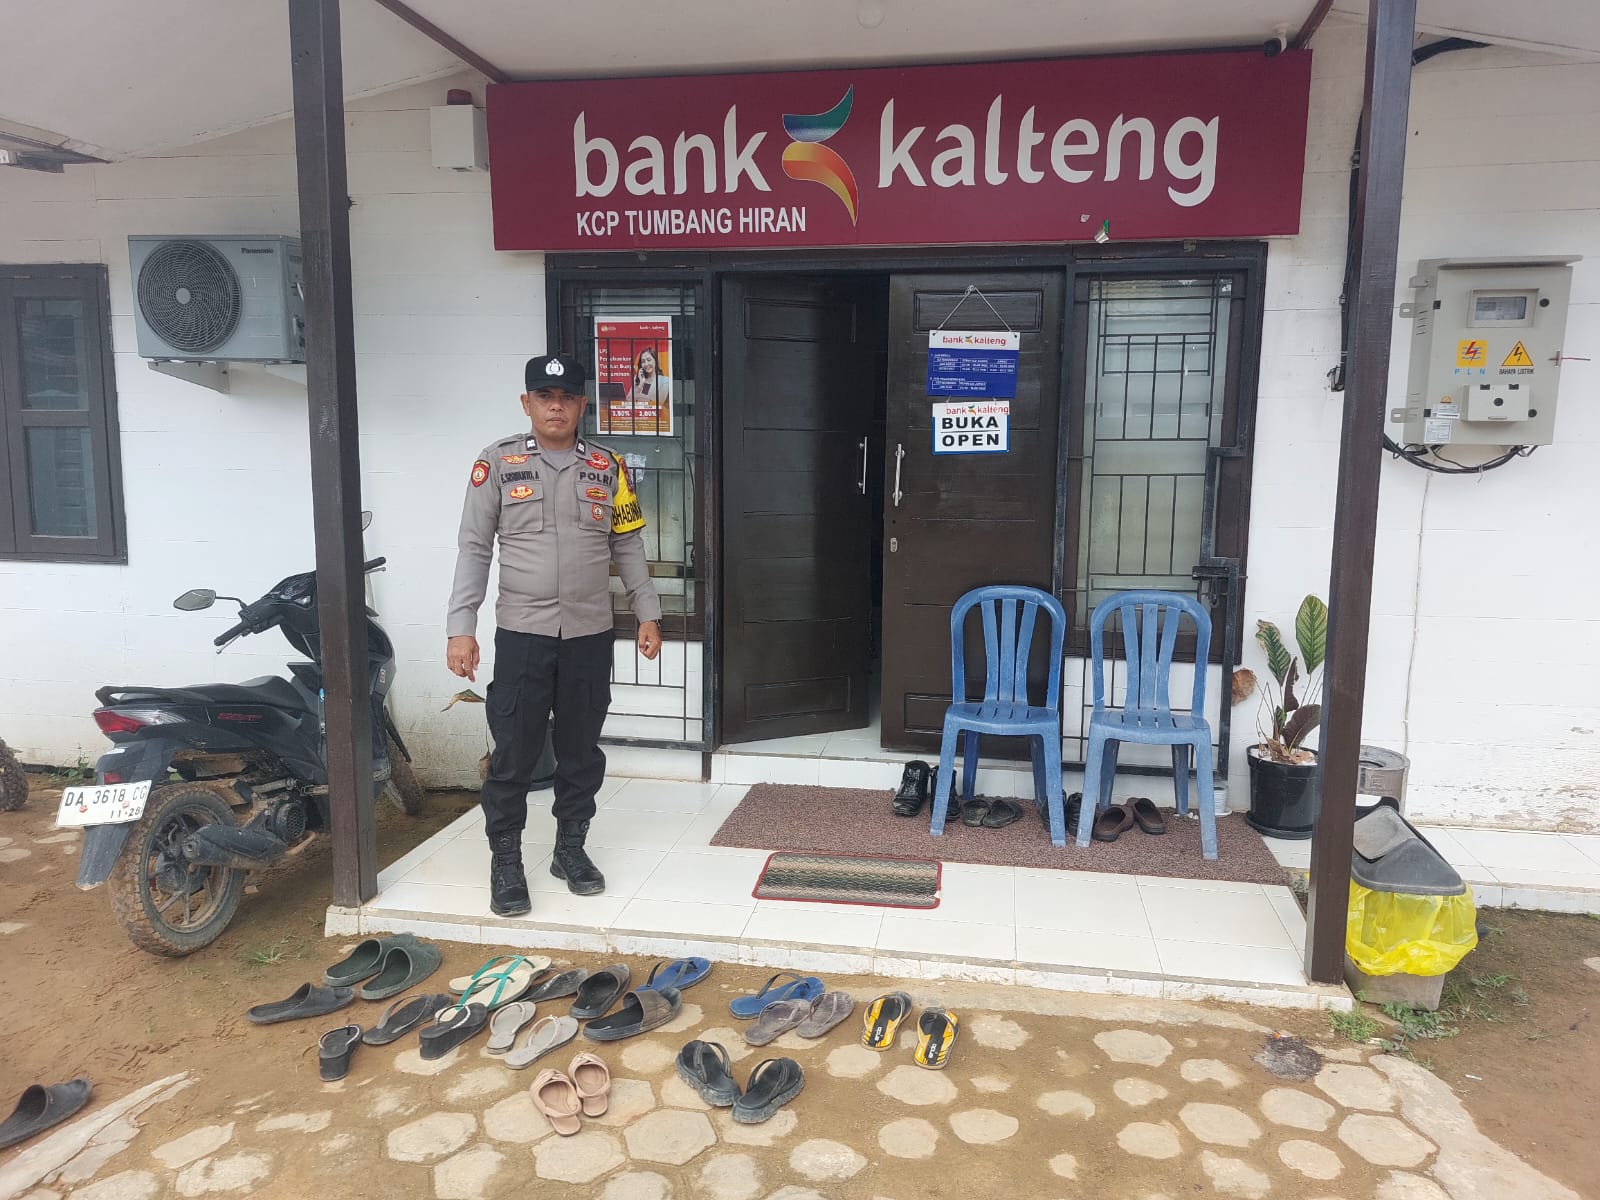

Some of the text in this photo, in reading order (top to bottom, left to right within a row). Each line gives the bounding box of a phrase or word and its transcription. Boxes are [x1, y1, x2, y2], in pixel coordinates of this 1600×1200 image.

[573, 94, 1220, 207] bank kalteng
[576, 206, 806, 236] KCP TUMBANG HIRAN
[974, 337, 1006, 346] kalteng
[946, 405, 1009, 415] bank kalteng
[942, 416, 999, 429] BUKA
[942, 434, 1000, 447] OPEN
[579, 471, 613, 486] POLRI
[64, 792, 84, 807] DA
[93, 788, 126, 805] 3618
